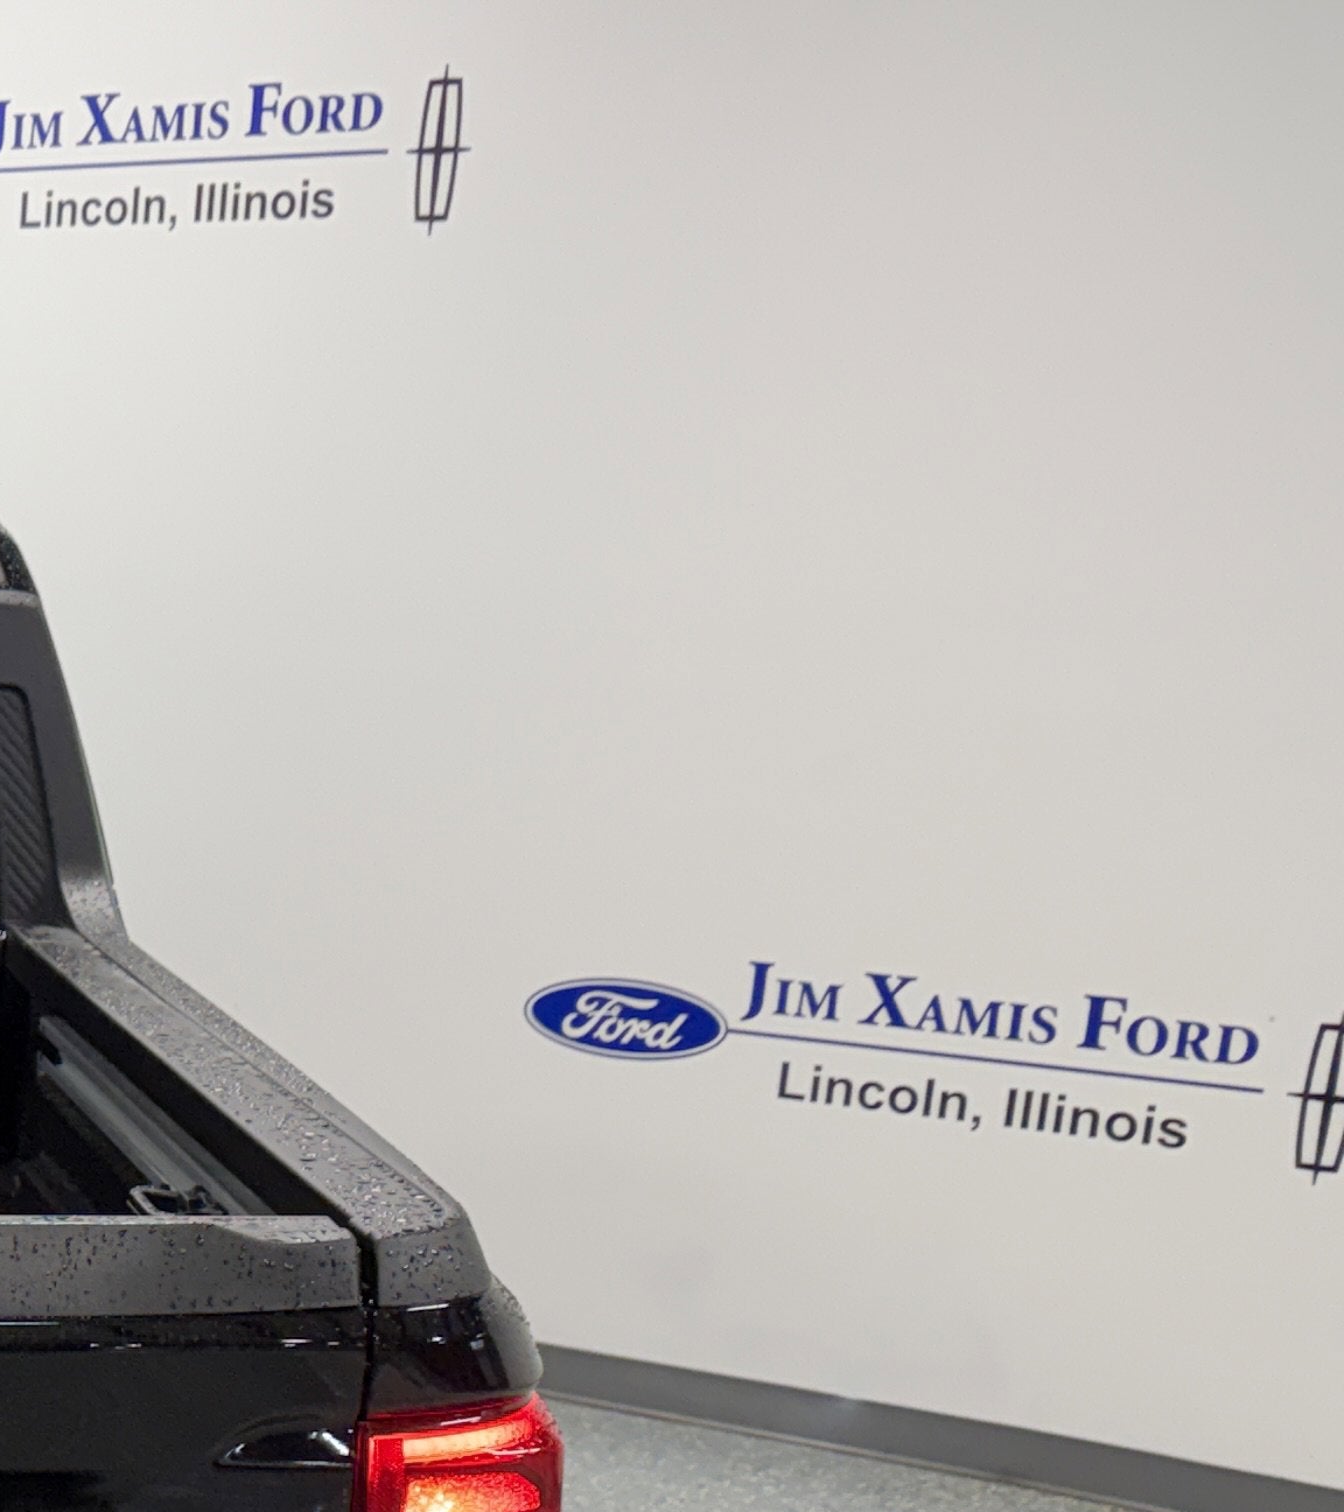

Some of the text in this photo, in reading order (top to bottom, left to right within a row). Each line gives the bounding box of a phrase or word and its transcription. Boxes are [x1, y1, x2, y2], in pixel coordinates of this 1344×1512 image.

[77, 94, 228, 145] XAMIS
[246, 83, 382, 136] FORD
[21, 180, 333, 230] Lincoln, Illinois
[560, 989, 687, 1052] Ford
[741, 962, 1258, 1064] JIM XAMIS FORD
[778, 1063, 1186, 1148] Lincoln, Illinois
